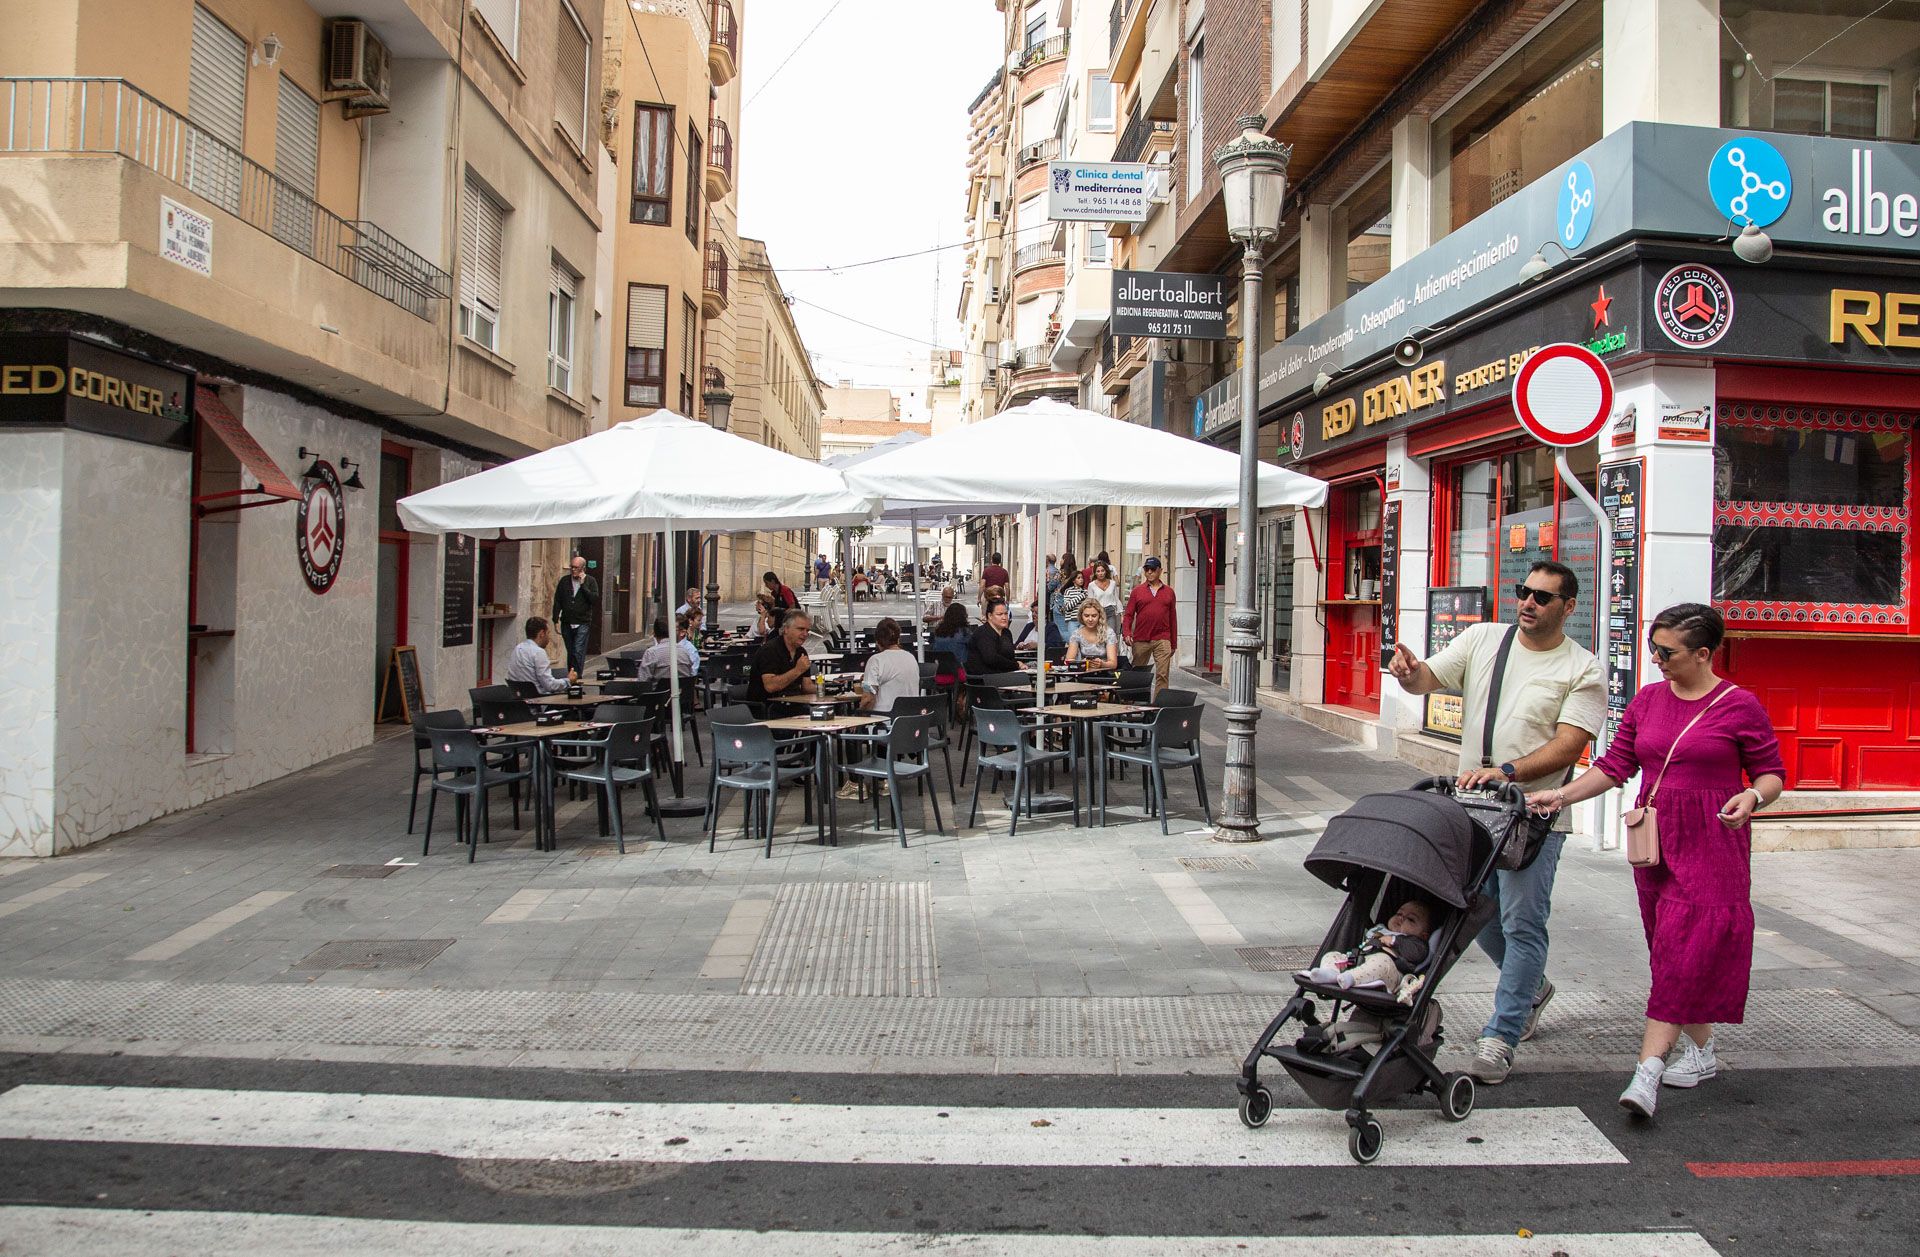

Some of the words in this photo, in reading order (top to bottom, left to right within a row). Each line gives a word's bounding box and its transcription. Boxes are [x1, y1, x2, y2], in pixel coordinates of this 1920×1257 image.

[1111, 170, 1143, 180] dental
[1074, 182, 1142, 194] mediterránea
[1062, 206, 1142, 216] www.cdmediterranea.es
[1093, 197, 1107, 205] 965
[1121, 198, 1130, 206] 48
[1118, 277, 1222, 304] albertoalbert
[1663, 275, 1681, 296] RED
[1683, 270, 1726, 300] CORNER
[1116, 307, 1141, 316] MEDICINA
[1142, 308, 1179, 319] REGENERATIVA
[1183, 310, 1223, 320] OZONOTERAPIA
[1278, 359, 1288, 380] del
[1288, 353, 1303, 375] dolor
[1308, 323, 1354, 363] Ozonoterapia
[1360, 294, 1405, 335] Osteopatía
[1413, 233, 1519, 307] Antienvejecimiento
[1147, 323, 1161, 333] 965
[1162, 324, 1171, 334] 21
[1173, 324, 1182, 335] 75
[1184, 325, 1192, 335] 11
[1662, 311, 1705, 341] SPORTS
[1707, 313, 1726, 336] BAR
[0, 365, 66, 395] ED
[69, 367, 165, 417] CORNER
[1322, 398, 1357, 441] RED
[1362, 360, 1446, 426] CORNER
[1455, 359, 1506, 395] SPORTS
[1620, 494, 1633, 504] SOL
[300, 536, 328, 586] SPORTS
[329, 539, 342, 576] BAR
